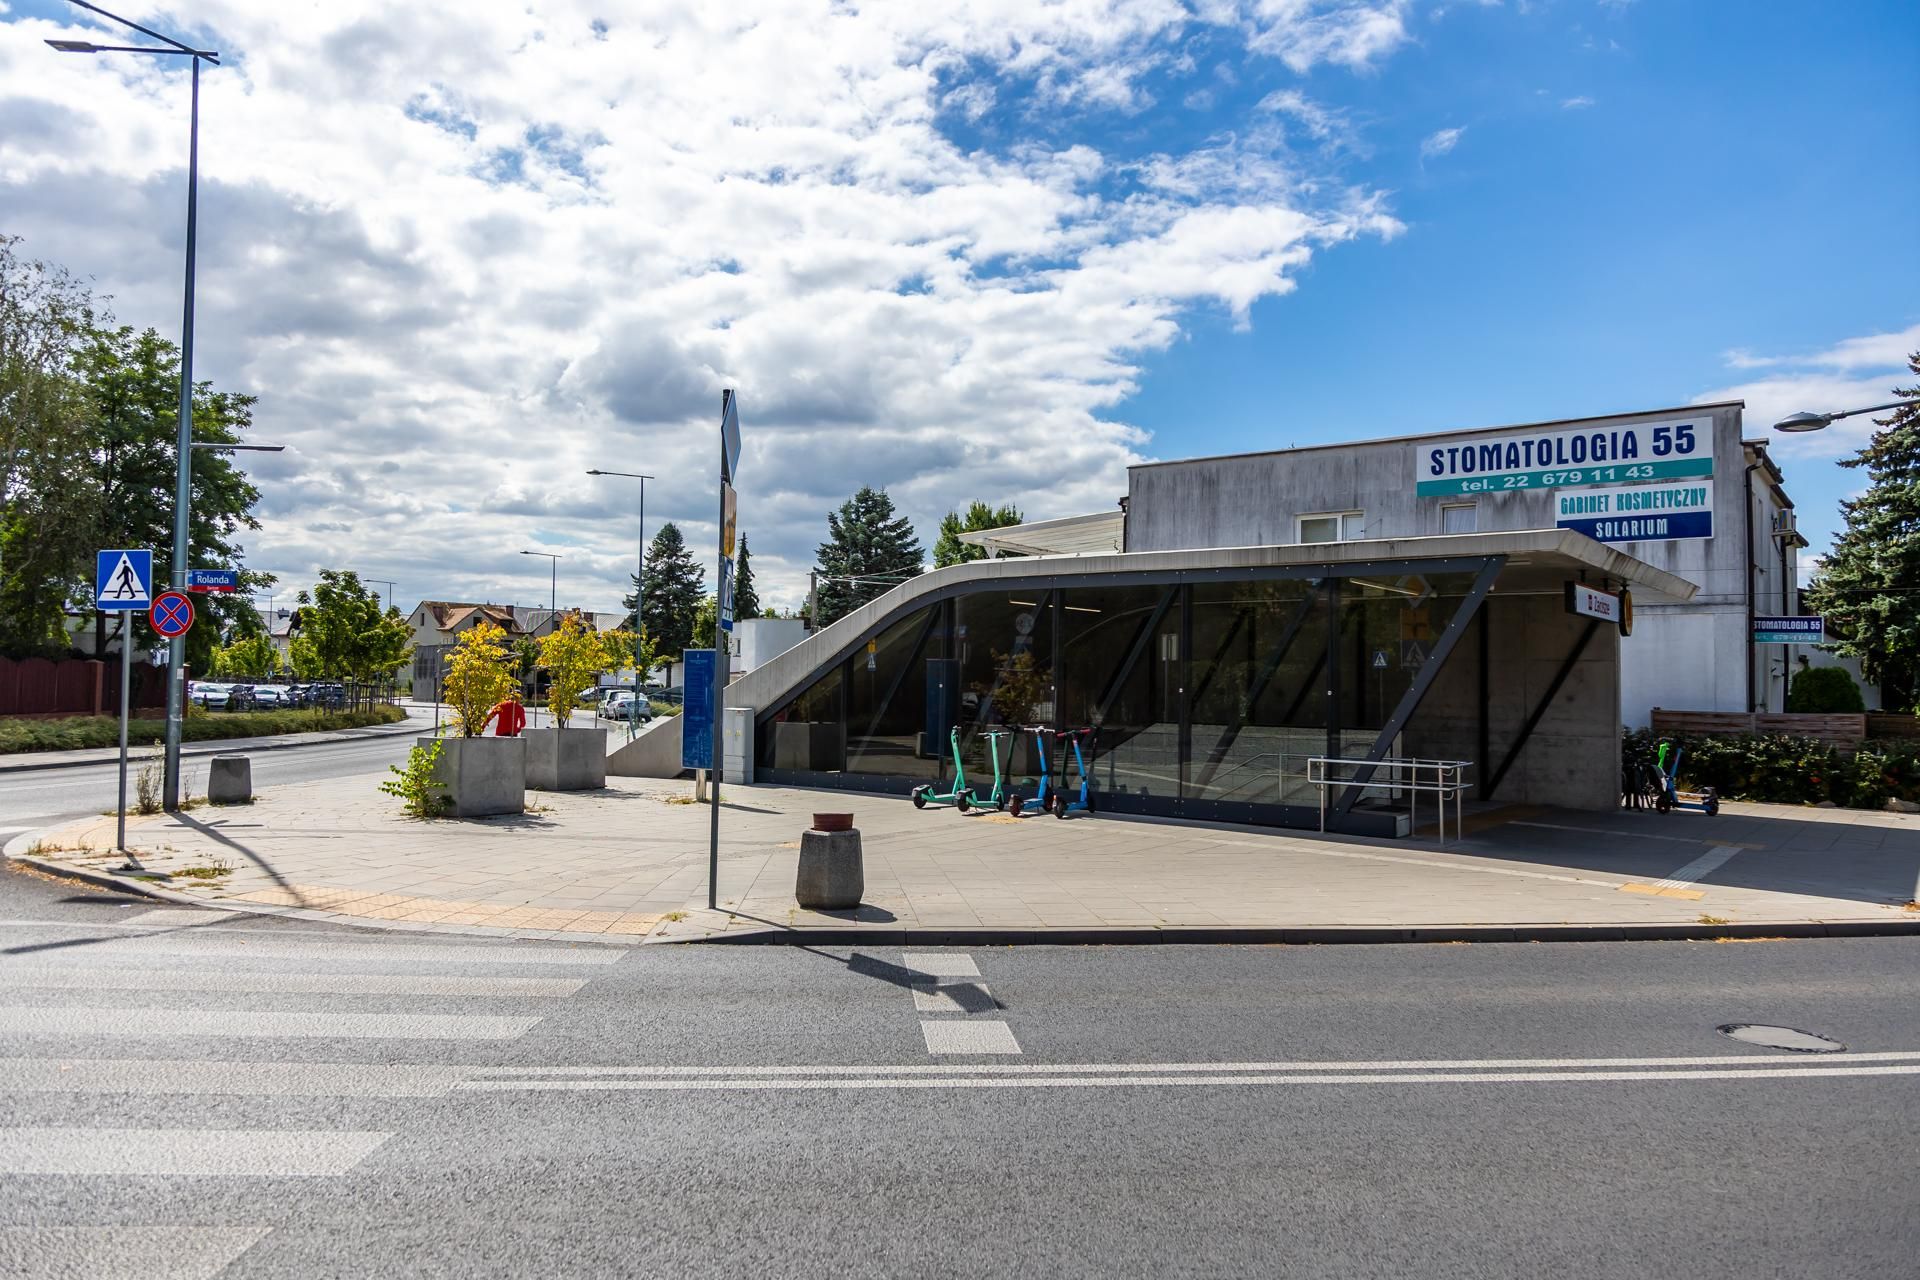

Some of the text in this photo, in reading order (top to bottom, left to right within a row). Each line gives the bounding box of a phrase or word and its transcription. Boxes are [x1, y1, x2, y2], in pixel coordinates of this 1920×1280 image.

[1431, 424, 1695, 475] STOMATOLOGIA 55
[1461, 465, 1654, 491] tel. 22 679 11 43
[1561, 487, 1706, 515] GABINET KOSMETYCZNY
[1596, 518, 1669, 538] SOLARIUM
[197, 575, 229, 584] Rolanda
[1754, 620, 1820, 630] STOMATOLOGIA 55
